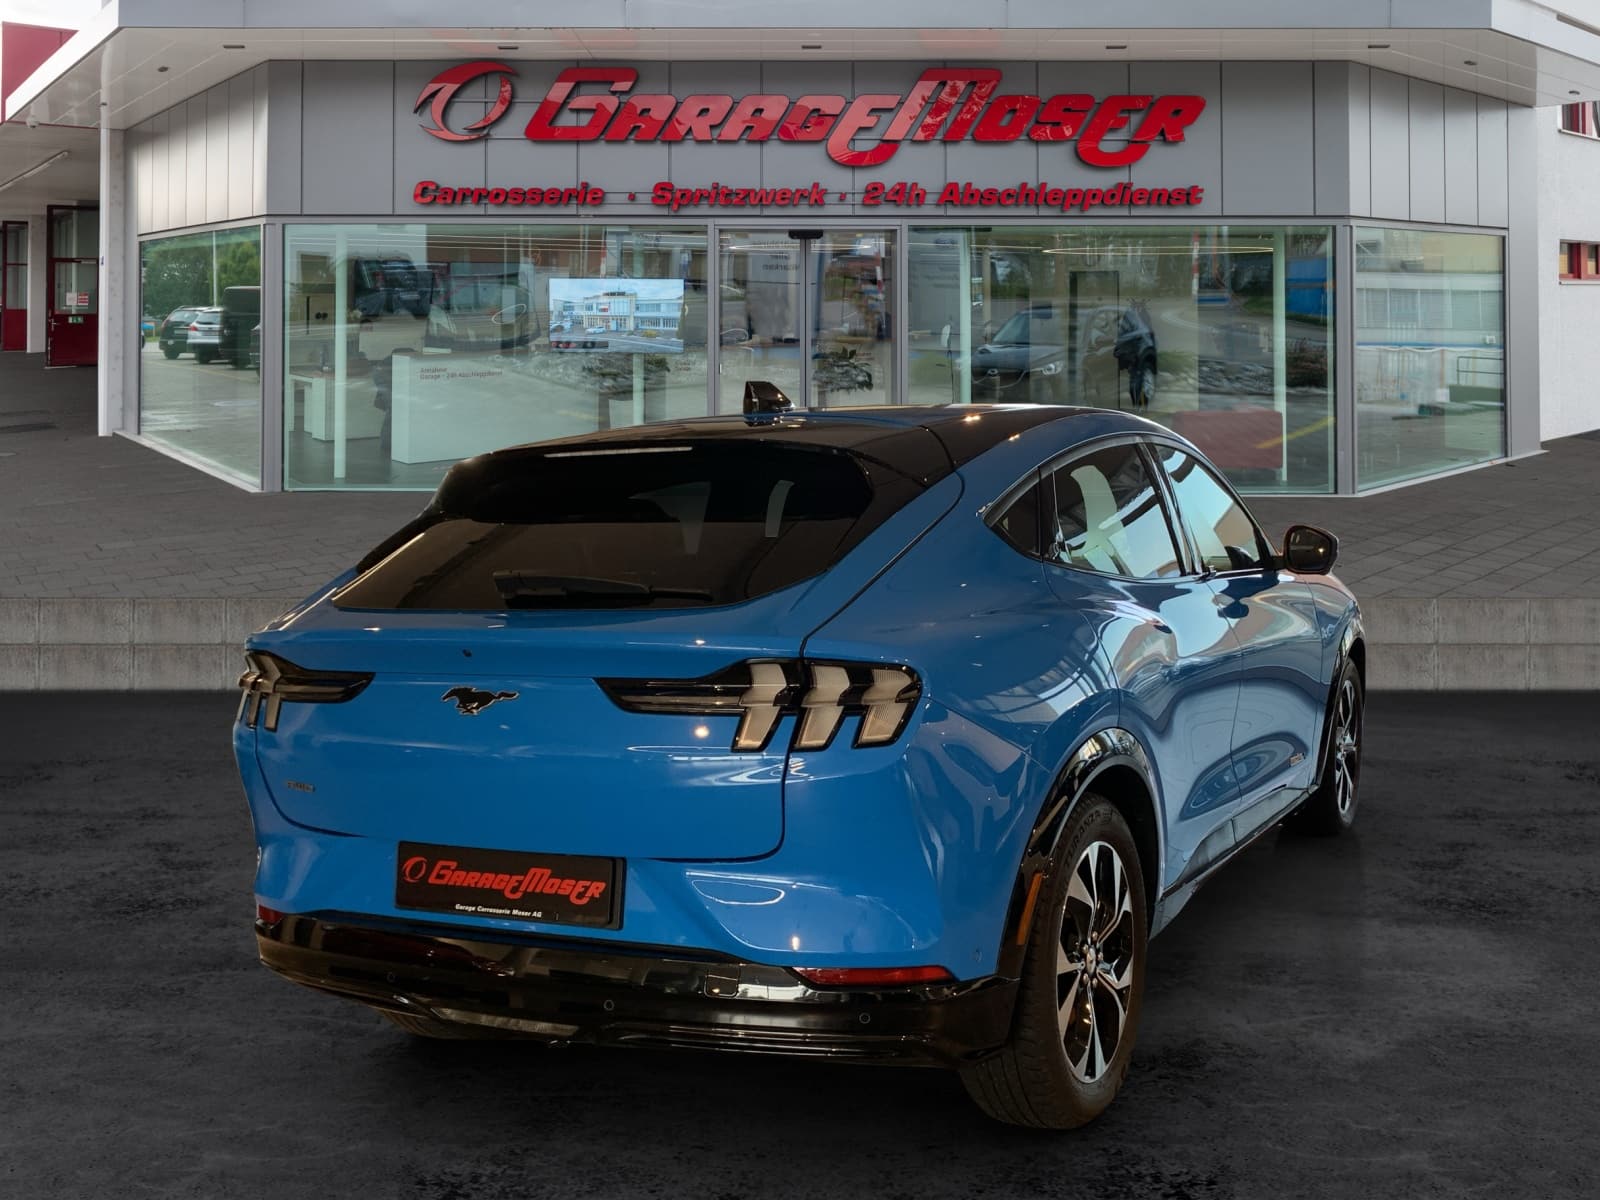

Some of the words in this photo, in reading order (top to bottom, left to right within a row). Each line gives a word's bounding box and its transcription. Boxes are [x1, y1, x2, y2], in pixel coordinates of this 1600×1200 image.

[412, 180, 605, 206] Carrosserie
[651, 181, 827, 212] Spritzwerk
[863, 181, 927, 206] 24h
[936, 181, 1204, 212] Abschleppdienst
[455, 903, 476, 912] Garage
[477, 905, 511, 915] Carrosserie
[512, 909, 532, 917] Moser
